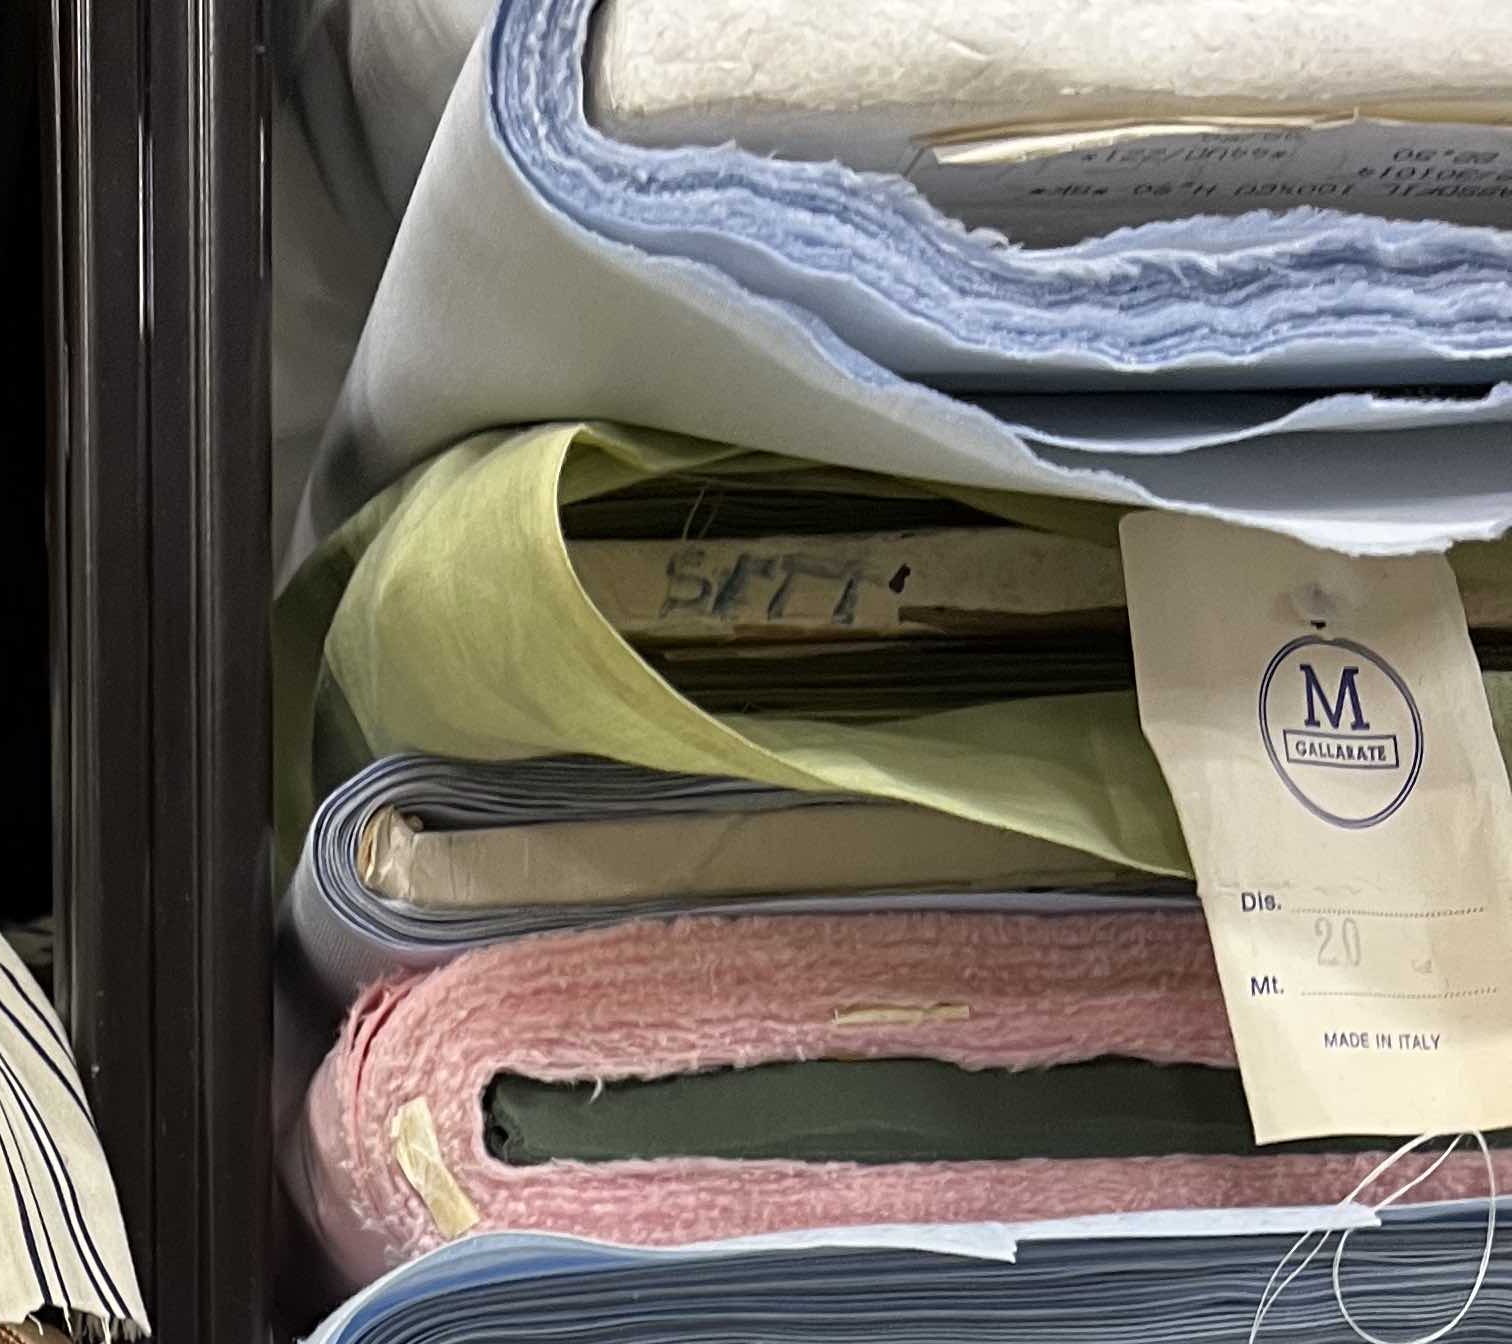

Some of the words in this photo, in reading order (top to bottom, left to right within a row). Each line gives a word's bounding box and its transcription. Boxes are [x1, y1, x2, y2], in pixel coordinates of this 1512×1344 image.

[1298, 663, 1370, 731] M
[1294, 740, 1387, 762] GALLARATE
[1240, 891, 1282, 913] Dis.
[1249, 976, 1284, 996] Mt.
[1323, 1032, 1370, 1050] MADE
[1375, 1032, 1393, 1050] IN
[1397, 1032, 1441, 1051] ITALY
